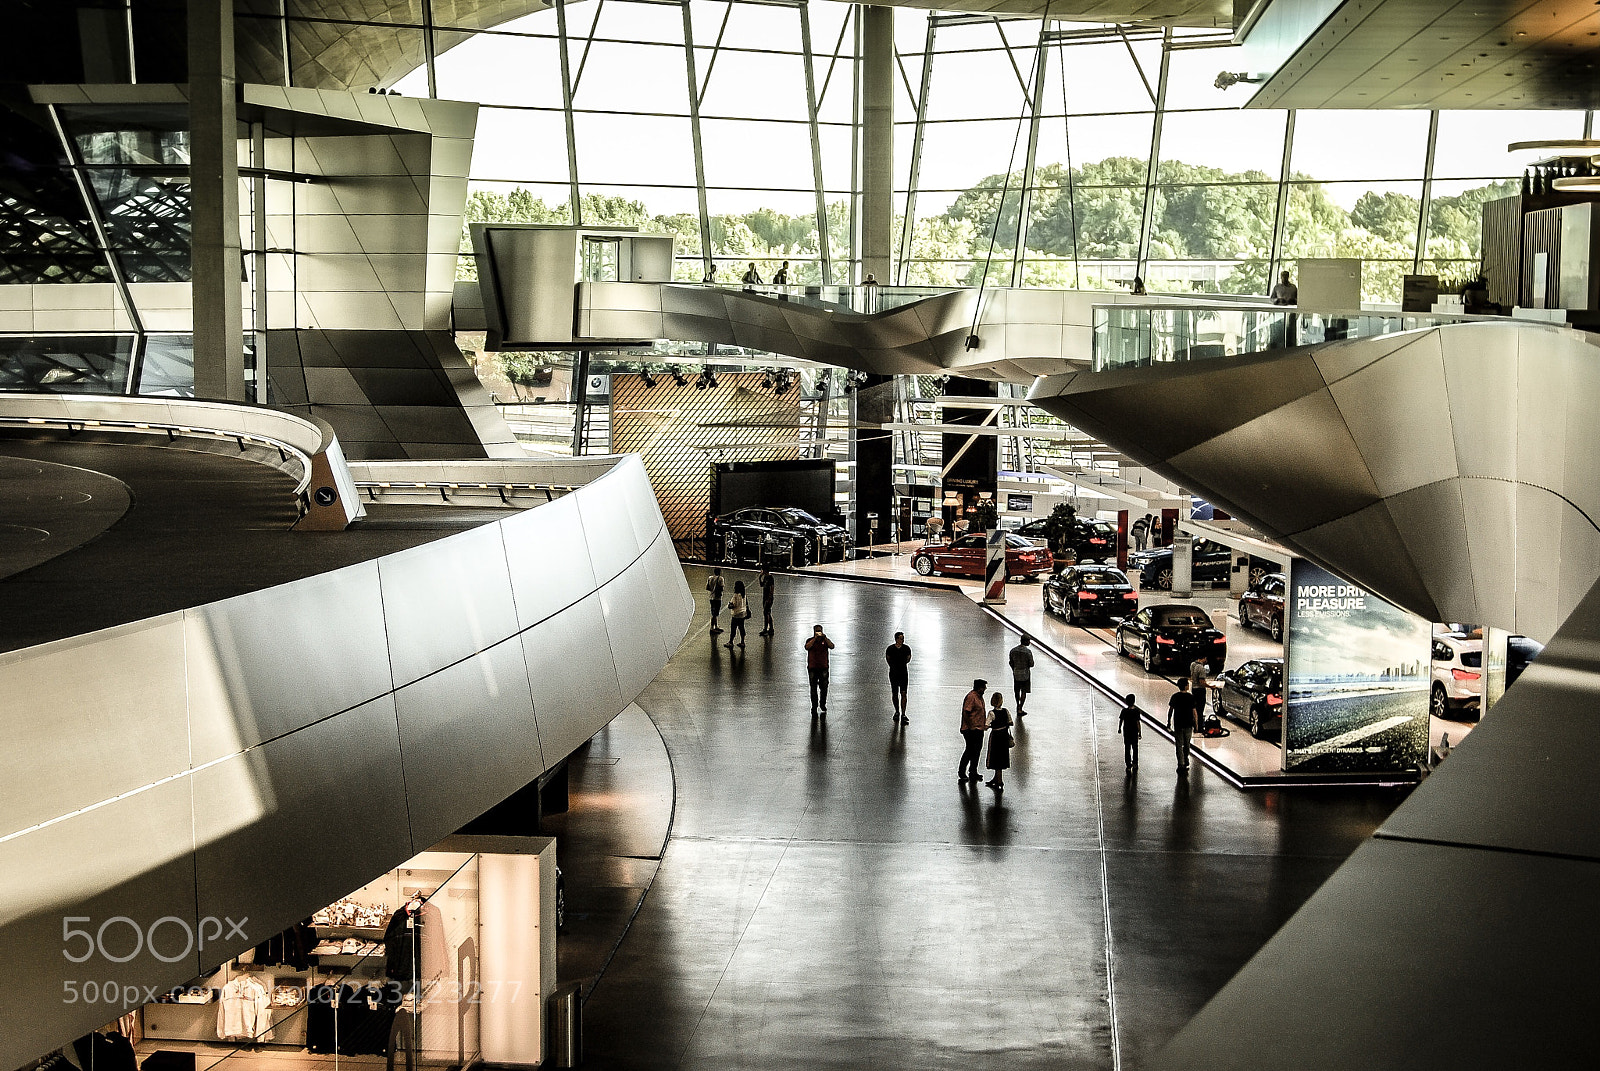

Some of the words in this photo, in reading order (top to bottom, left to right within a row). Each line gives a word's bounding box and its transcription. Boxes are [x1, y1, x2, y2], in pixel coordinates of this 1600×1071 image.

[1297, 585, 1336, 597] MORE
[1337, 585, 1370, 597] DRIV
[1297, 598, 1367, 610] PLEASURE.
[1297, 610, 1315, 618] LESS
